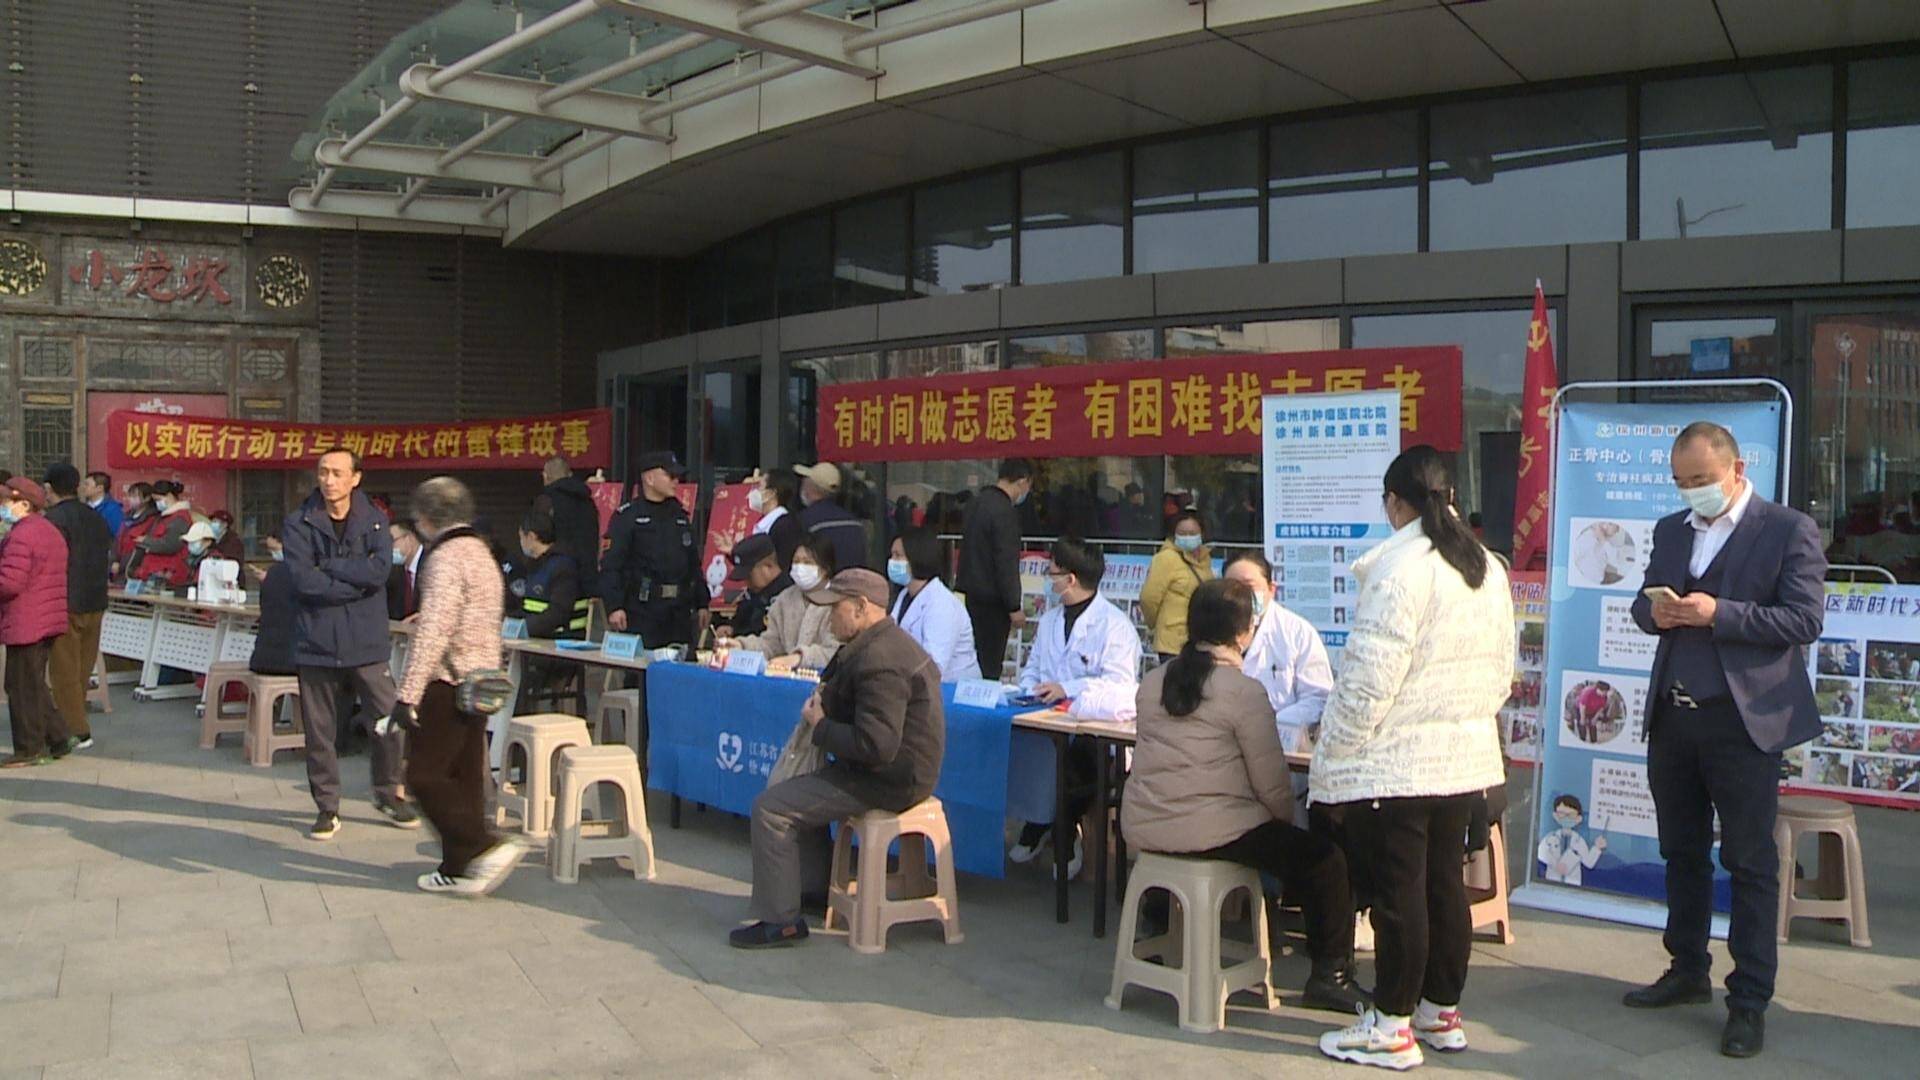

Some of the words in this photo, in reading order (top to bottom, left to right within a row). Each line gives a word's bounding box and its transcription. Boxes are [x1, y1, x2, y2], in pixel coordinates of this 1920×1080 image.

[833, 382, 1059, 448] 有时间做志愿者
[1275, 406, 1387, 422] 徐州市肿瘤医院北院
[126, 418, 591, 461] 以实际行动书写新时代的雷锋故事
[1275, 423, 1387, 439] 徐州新健康医院
